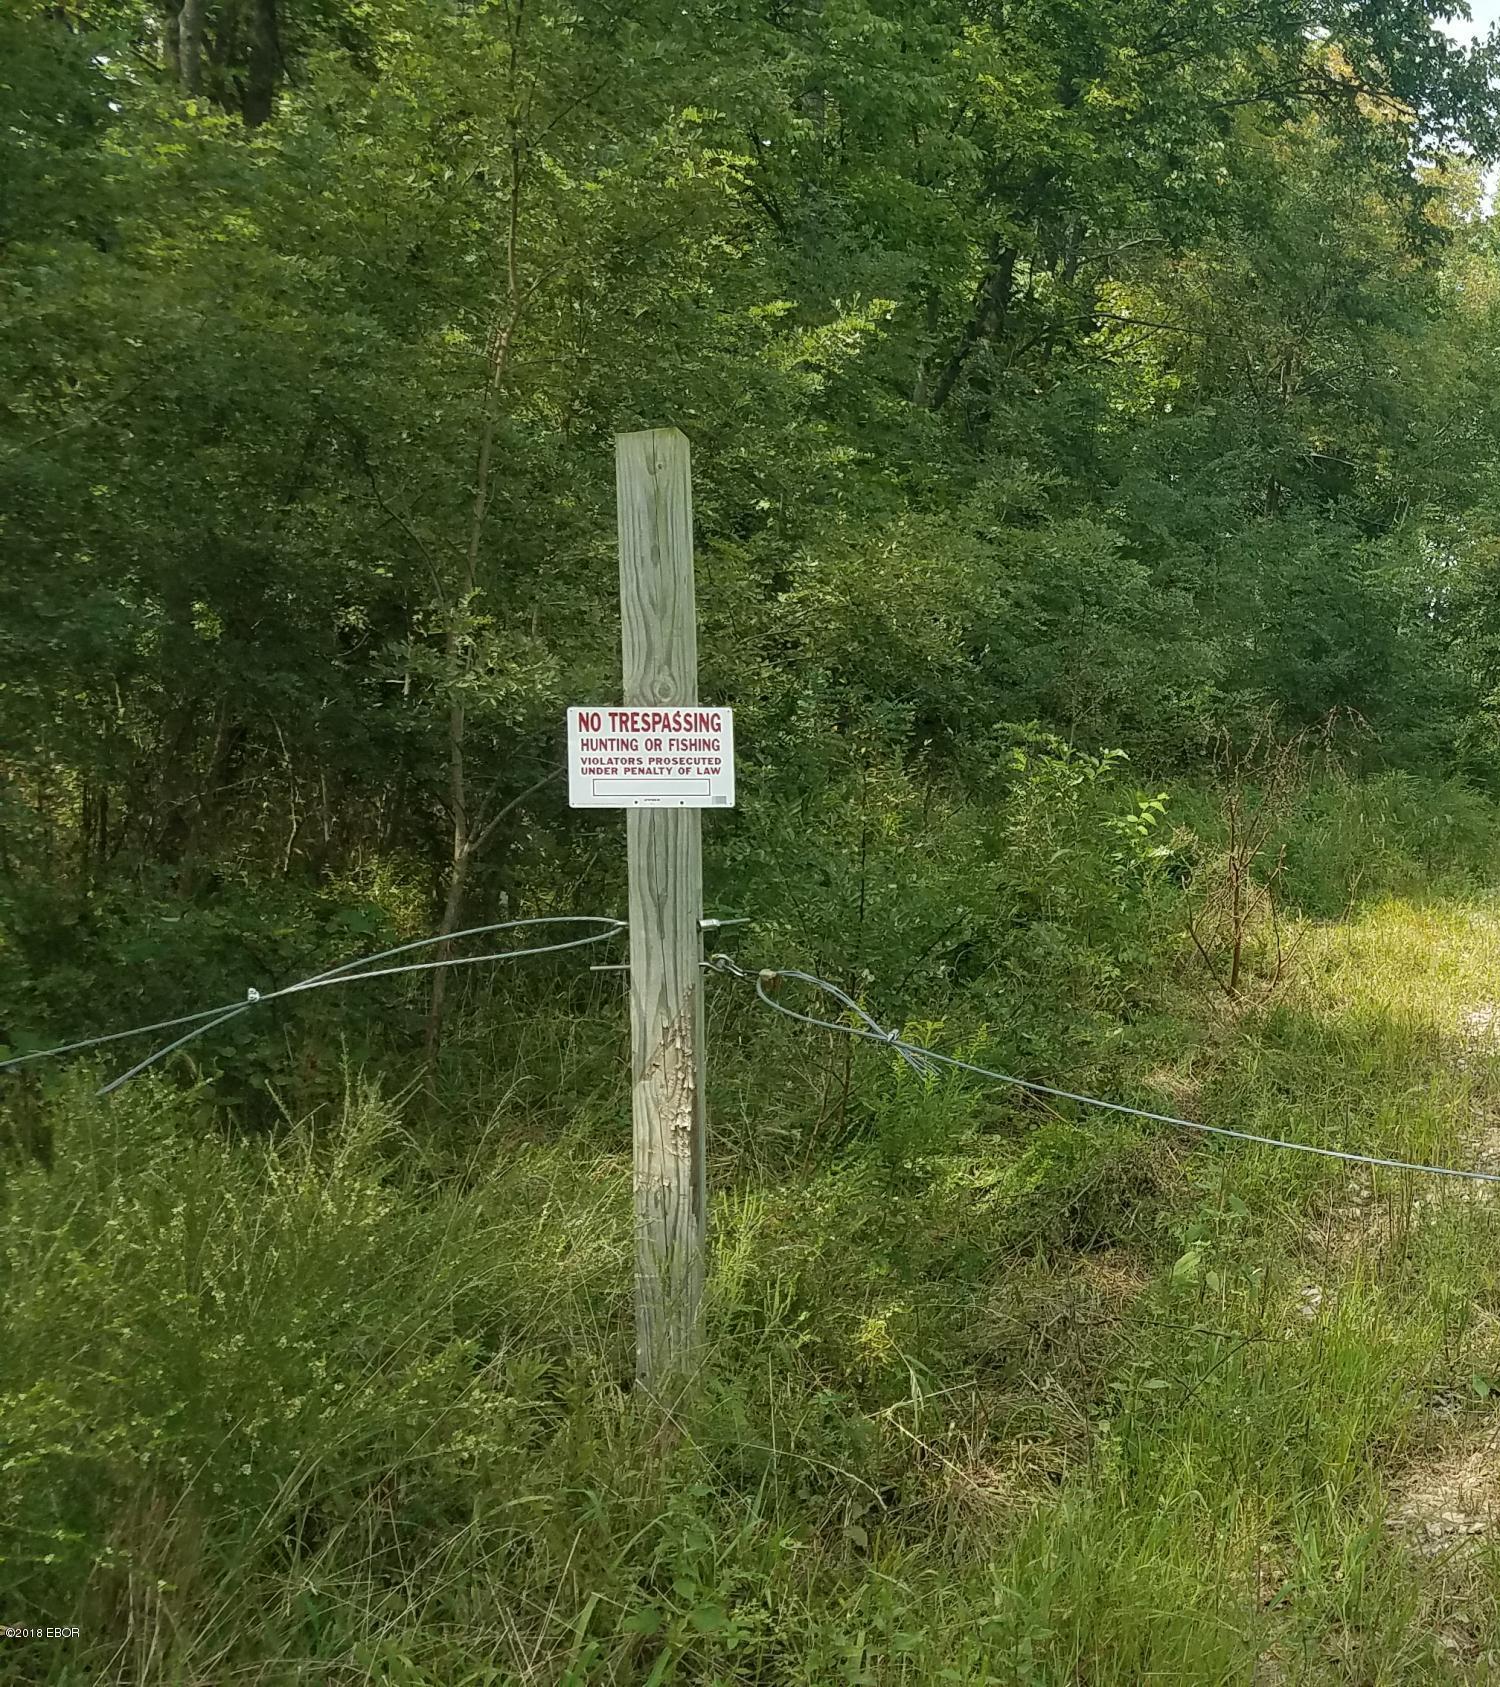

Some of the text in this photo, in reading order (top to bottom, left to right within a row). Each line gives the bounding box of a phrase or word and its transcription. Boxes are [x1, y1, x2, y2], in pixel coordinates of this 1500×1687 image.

[578, 712, 722, 733] NO TRESPASSING
[580, 738, 721, 751] HUNTING OR FISHING
[580, 757, 722, 765] VIOLATORS PROSECUTED
[581, 767, 721, 775] UNDER PENALTY OF LAW
